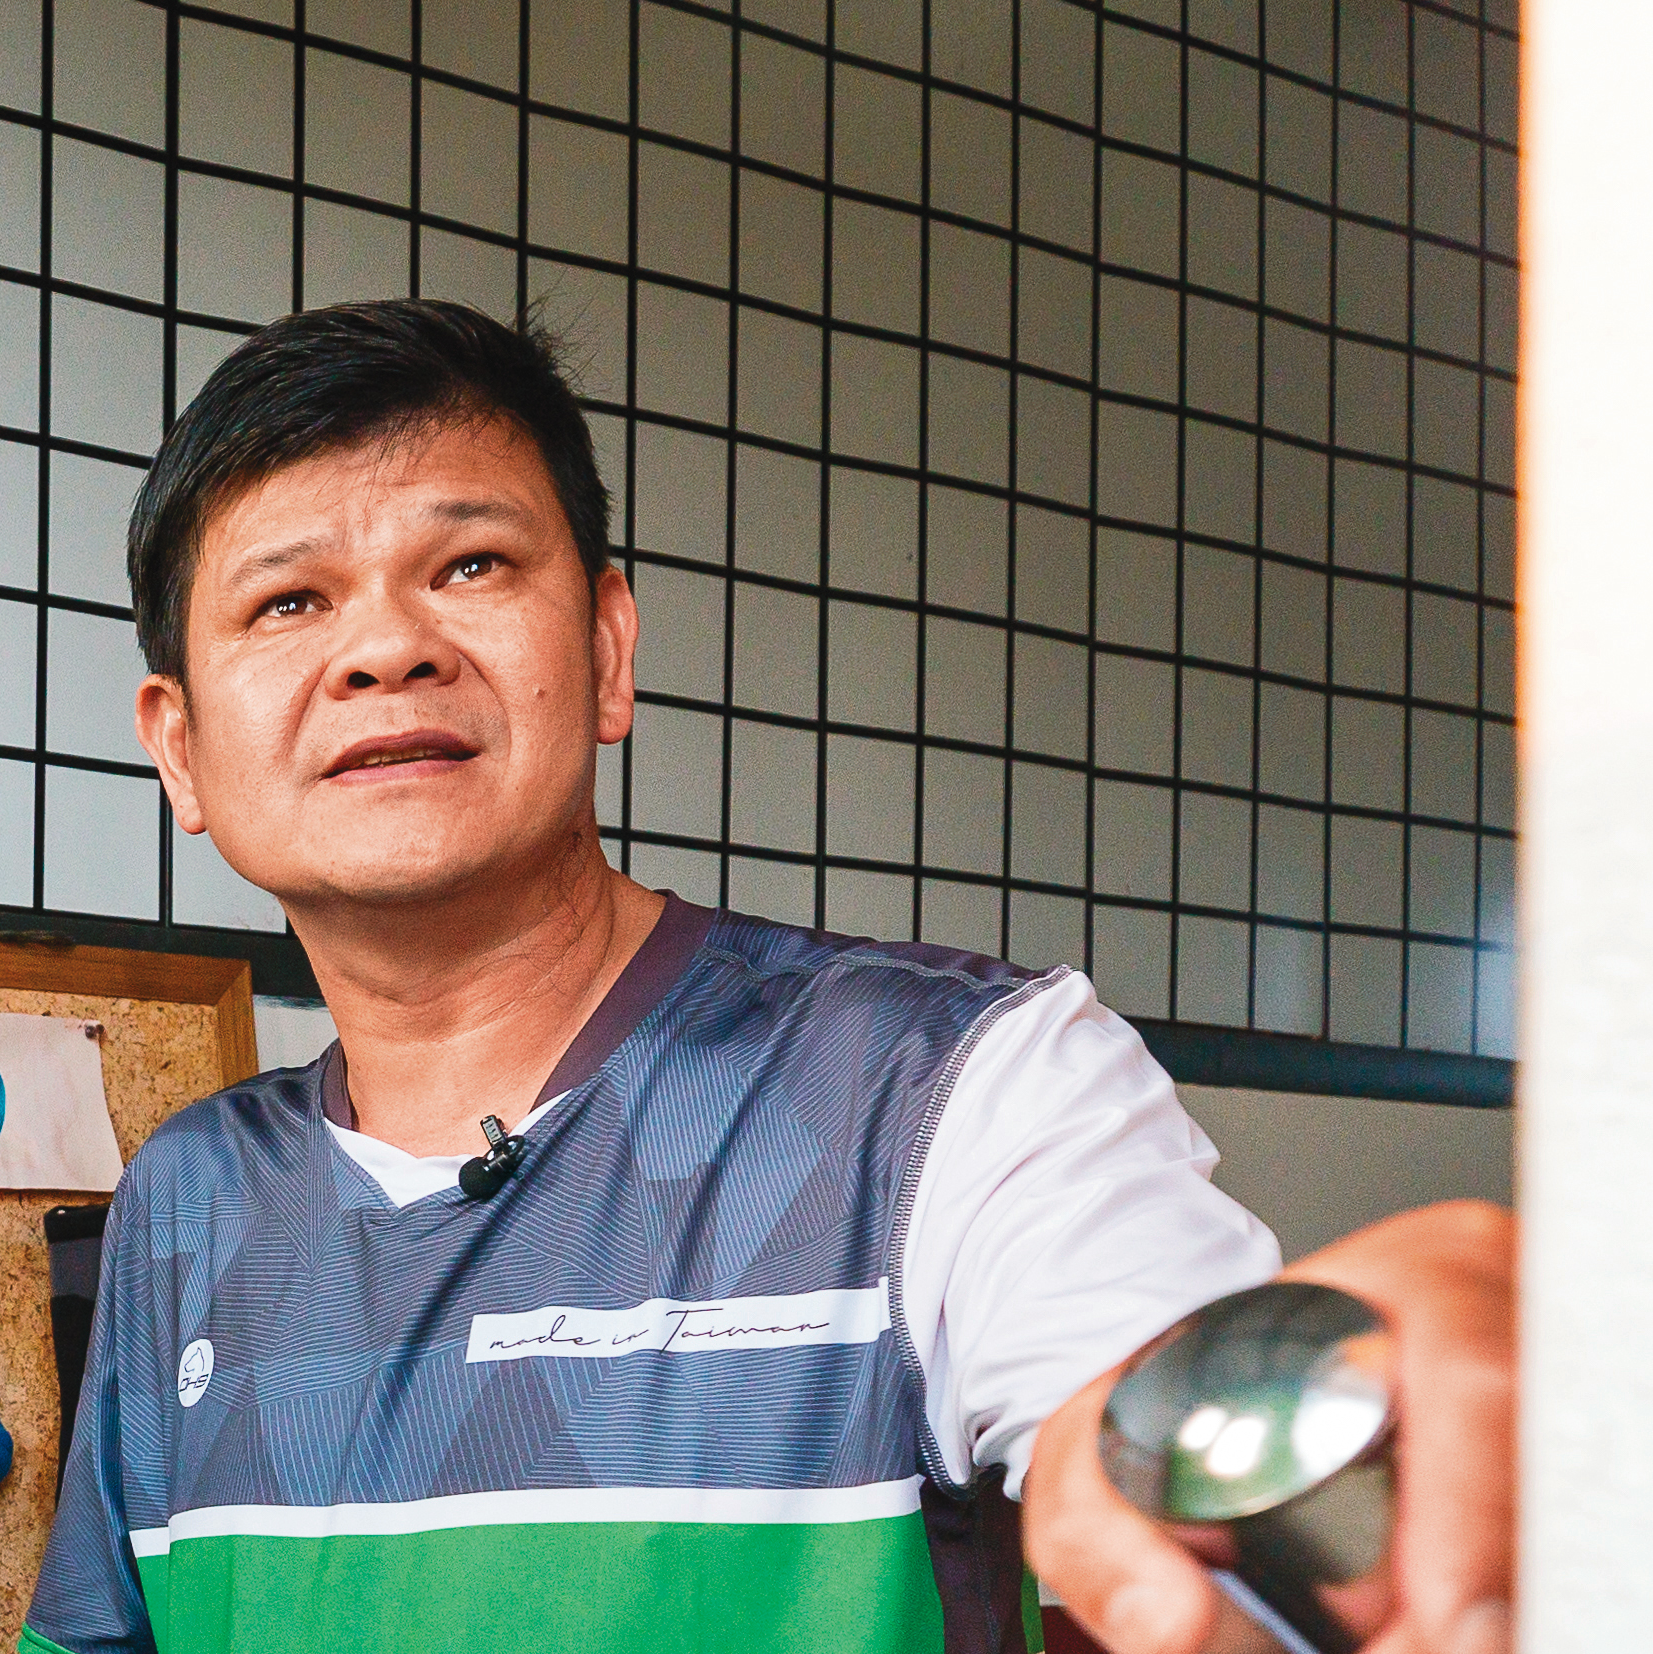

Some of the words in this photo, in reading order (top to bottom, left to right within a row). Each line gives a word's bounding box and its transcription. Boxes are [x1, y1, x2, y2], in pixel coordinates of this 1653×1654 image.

[489, 1314, 601, 1350] made
[659, 1307, 830, 1355] Taiwan
[179, 1373, 209, 1392] OH9
